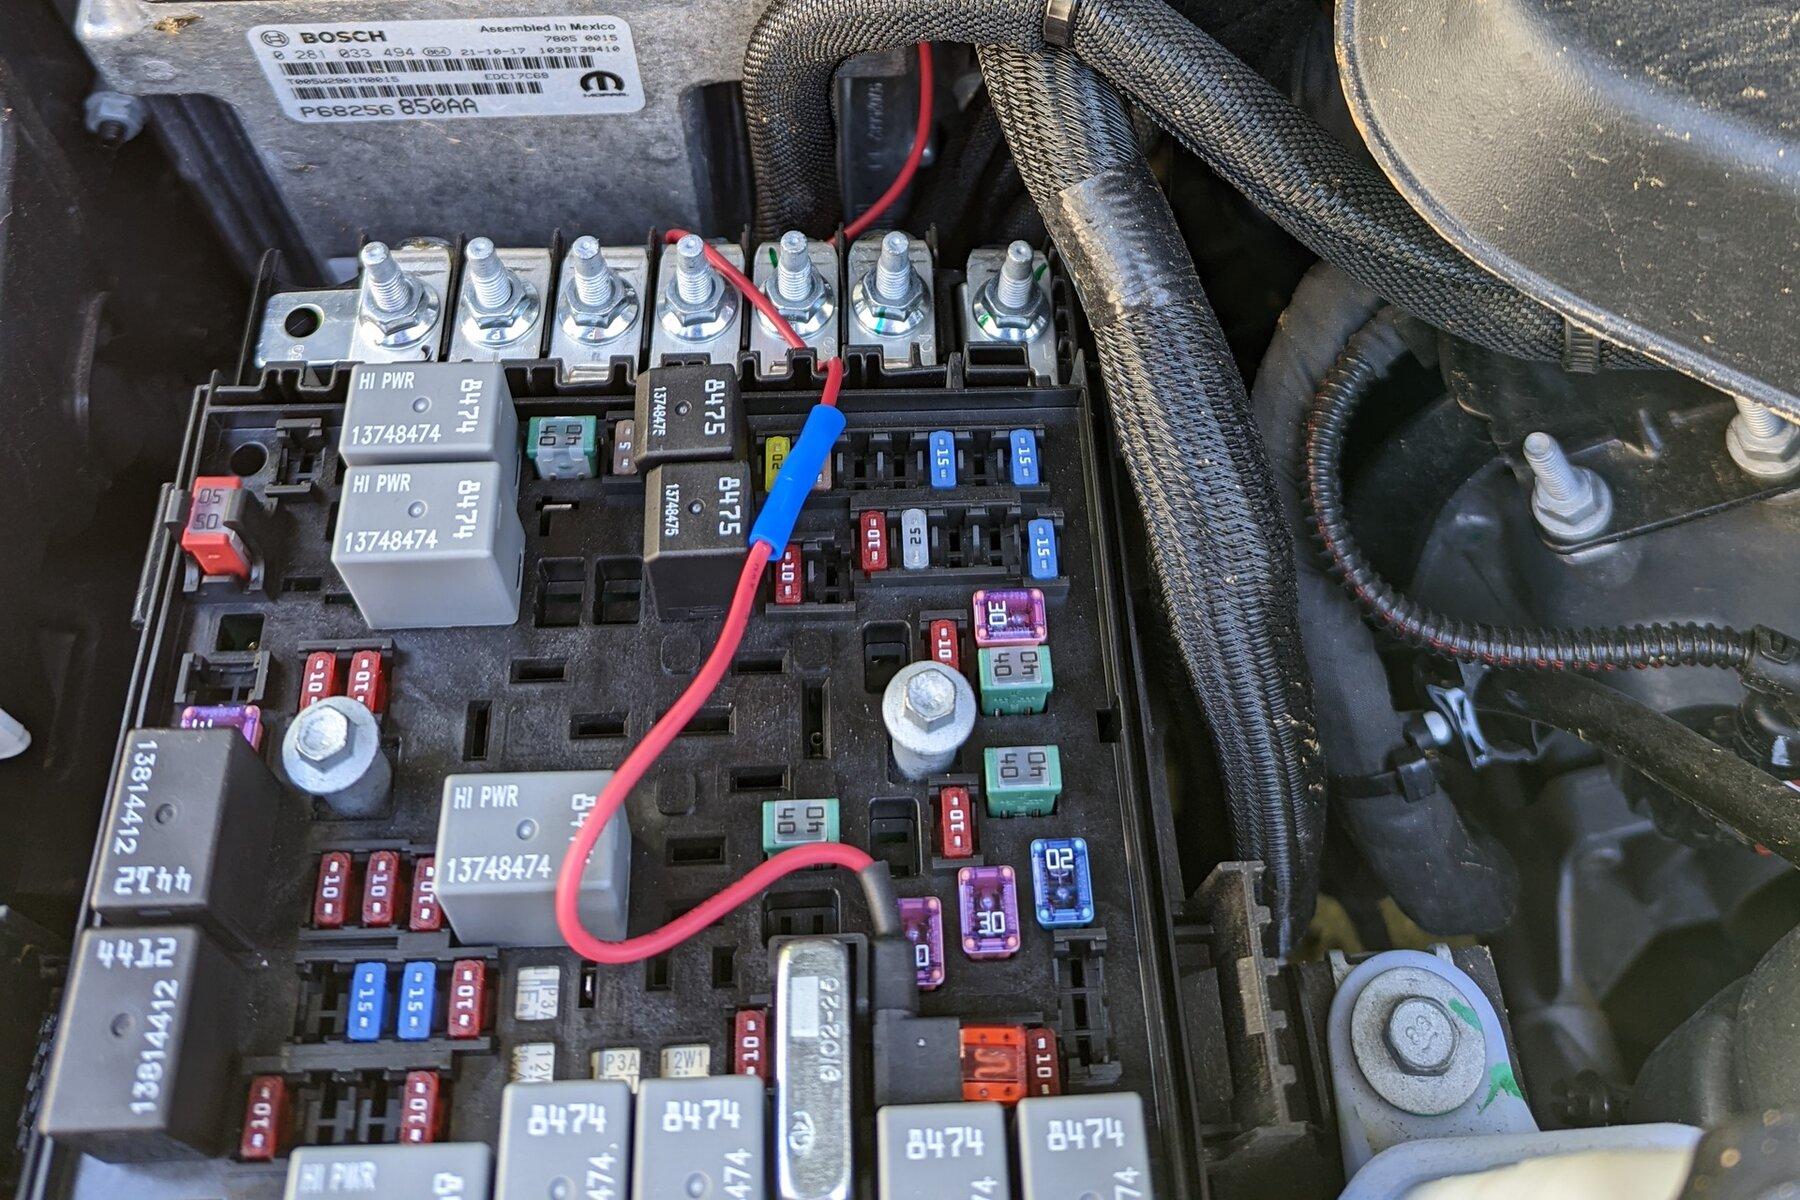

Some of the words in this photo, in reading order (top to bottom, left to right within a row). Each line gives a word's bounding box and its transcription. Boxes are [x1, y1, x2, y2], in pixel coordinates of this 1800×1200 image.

[300, 30, 388, 44] BOSCH
[480, 23, 551, 33] Assembled
[570, 22, 617, 31] Mexico
[544, 34, 578, 43] 7805
[584, 34, 618, 42] 0015
[273, 50, 286, 60] 0
[294, 49, 326, 60] 281
[338, 48, 373, 59] 033
[384, 47, 416, 58] 494
[460, 47, 526, 56] 21-10-17
[300, 104, 396, 118] P68256
[399, 98, 480, 116] 850AA
[359, 372, 376, 390] HI
[382, 371, 415, 389] PWR
[456, 378, 483, 434] 8474
[704, 378, 726, 436] 8475
[351, 423, 441, 445] 13748474
[539, 424, 557, 446] 40
[565, 424, 582, 446] 40
[936, 448, 949, 465] 15
[1018, 446, 1031, 464] 15
[353, 475, 370, 493] HI
[376, 473, 411, 492] PWR
[453, 480, 482, 540] 8474
[664, 483, 680, 537] 13748475
[718, 476, 741, 535] 8475
[193, 513, 219, 529] 50
[344, 529, 438, 553] 13748474
[867, 529, 881, 548] 10
[910, 527, 922, 544] 25
[1037, 538, 1050, 556] 15
[781, 562, 795, 582] 10
[988, 600, 1008, 626] 30
[937, 638, 953, 659] 10
[994, 652, 1012, 677] 40
[1020, 651, 1039, 676] 40
[307, 671, 325, 693] 10
[354, 670, 371, 692] 10
[1000, 752, 1018, 778] 40
[1028, 751, 1046, 777] 40
[113, 740, 158, 856] 13814412
[453, 786, 472, 810] HI
[480, 784, 519, 808] PWR
[778, 807, 796, 834] 40
[806, 806, 825, 833] 40
[949, 809, 964, 832] 10
[113, 865, 192, 896] 4412
[447, 854, 552, 883] 13748474
[322, 875, 340, 898] 10
[370, 873, 388, 897] 10
[418, 881, 435, 904] 10
[976, 910, 1005, 934] 30
[97, 937, 177, 969] 4412
[357, 987, 375, 1012] 15
[407, 987, 425, 1012] 15
[456, 985, 475, 1009] 10
[129, 979, 179, 1115] 13814412
[742, 1036, 760, 1061] 10
[1036, 1053, 1052, 1078] 10
[250, 1102, 272, 1128] 10
[408, 1097, 428, 1124] 10
[527, 1102, 607, 1136] 8474
[662, 1099, 741, 1132] 8474
[906, 1126, 985, 1160] 8474
[1047, 1117, 1126, 1151] 8474
